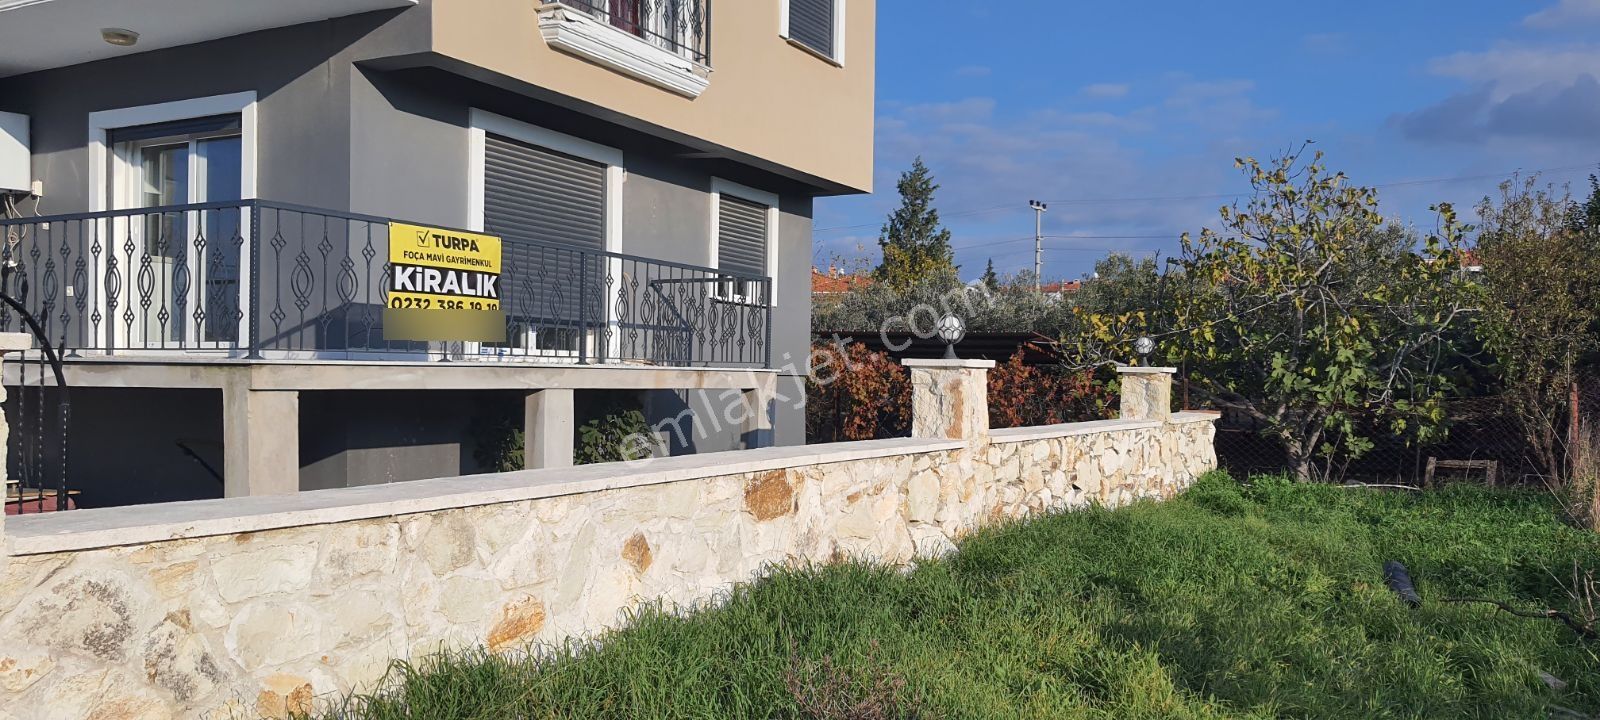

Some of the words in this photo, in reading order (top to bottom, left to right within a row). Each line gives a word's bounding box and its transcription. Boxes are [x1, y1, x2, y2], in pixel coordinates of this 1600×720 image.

[432, 234, 480, 252] TURPA
[403, 250, 425, 262] FOÇA
[426, 252, 445, 263] MAVİ
[446, 256, 492, 268] GAYRİMENKUL
